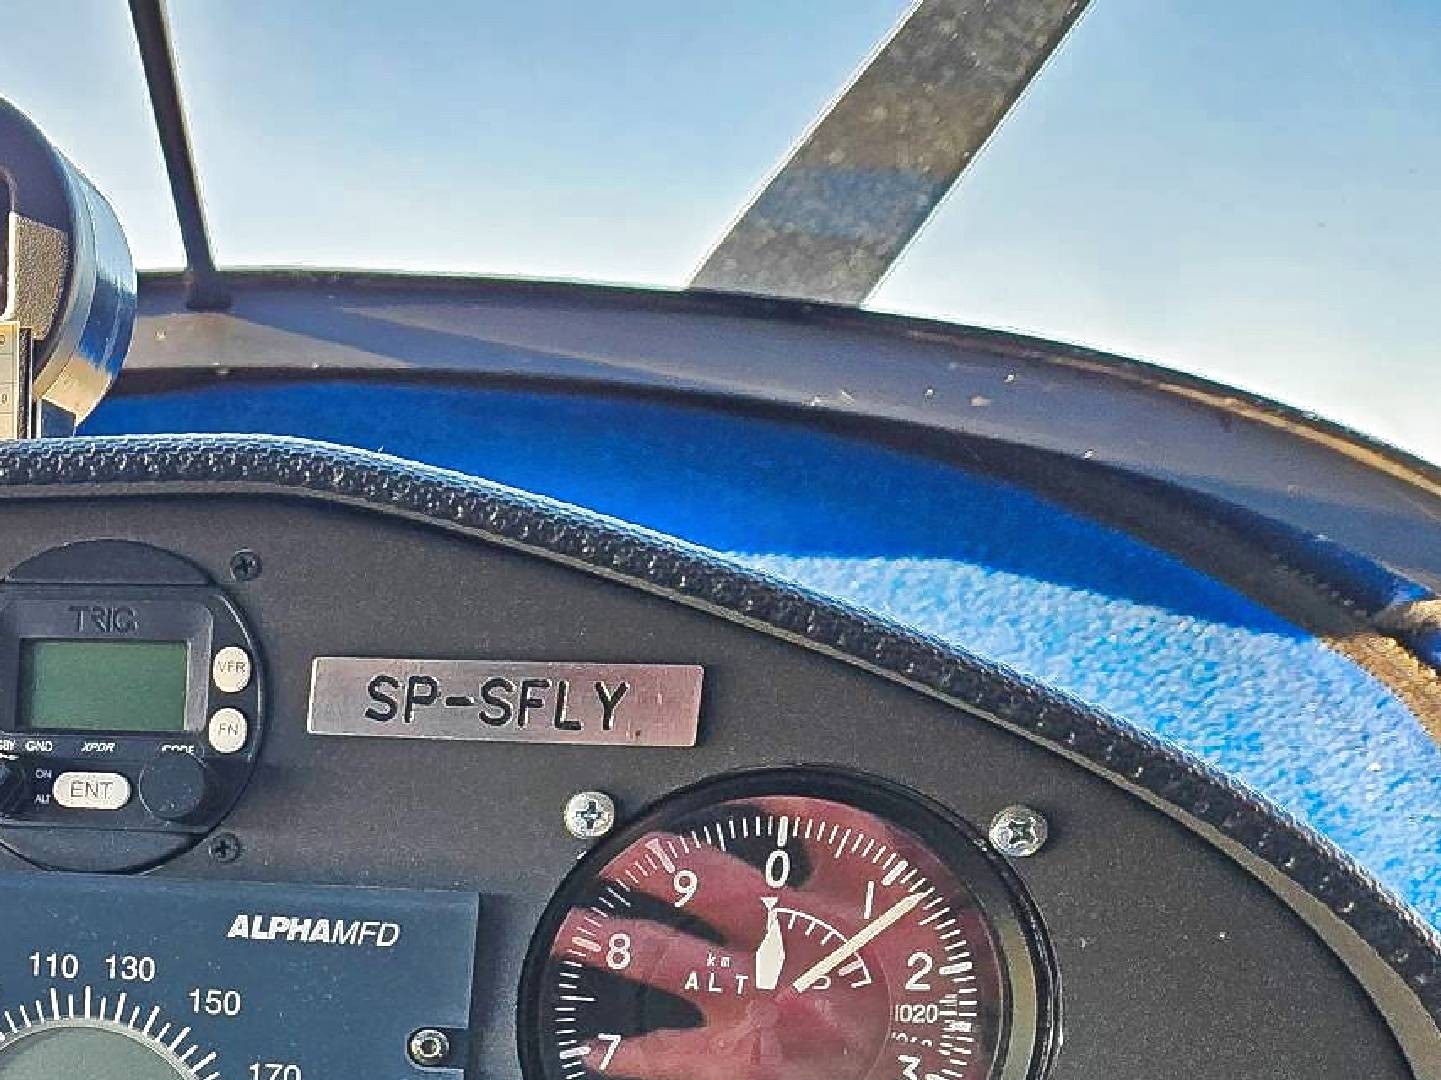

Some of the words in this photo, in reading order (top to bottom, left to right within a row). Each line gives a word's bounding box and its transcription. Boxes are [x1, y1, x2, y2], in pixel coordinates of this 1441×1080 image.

[68, 605, 140, 633] TRIG
[218, 661, 245, 673] VFR
[363, 674, 630, 732] SP-SFLY
[218, 723, 239, 736] FN
[25, 740, 53, 752] GND
[35, 768, 53, 780] ON
[33, 793, 51, 805] ALT
[70, 780, 114, 799] ENT
[765, 849, 791, 888] 0
[672, 870, 698, 908] 9
[606, 933, 632, 969] 8
[28, 953, 80, 980] 110
[105, 956, 157, 982] 130
[904, 951, 934, 991] 2
[684, 970, 749, 995] ALT
[189, 989, 242, 1016] 150
[894, 1003, 938, 1024] 1020
[598, 1033, 622, 1072] 7
